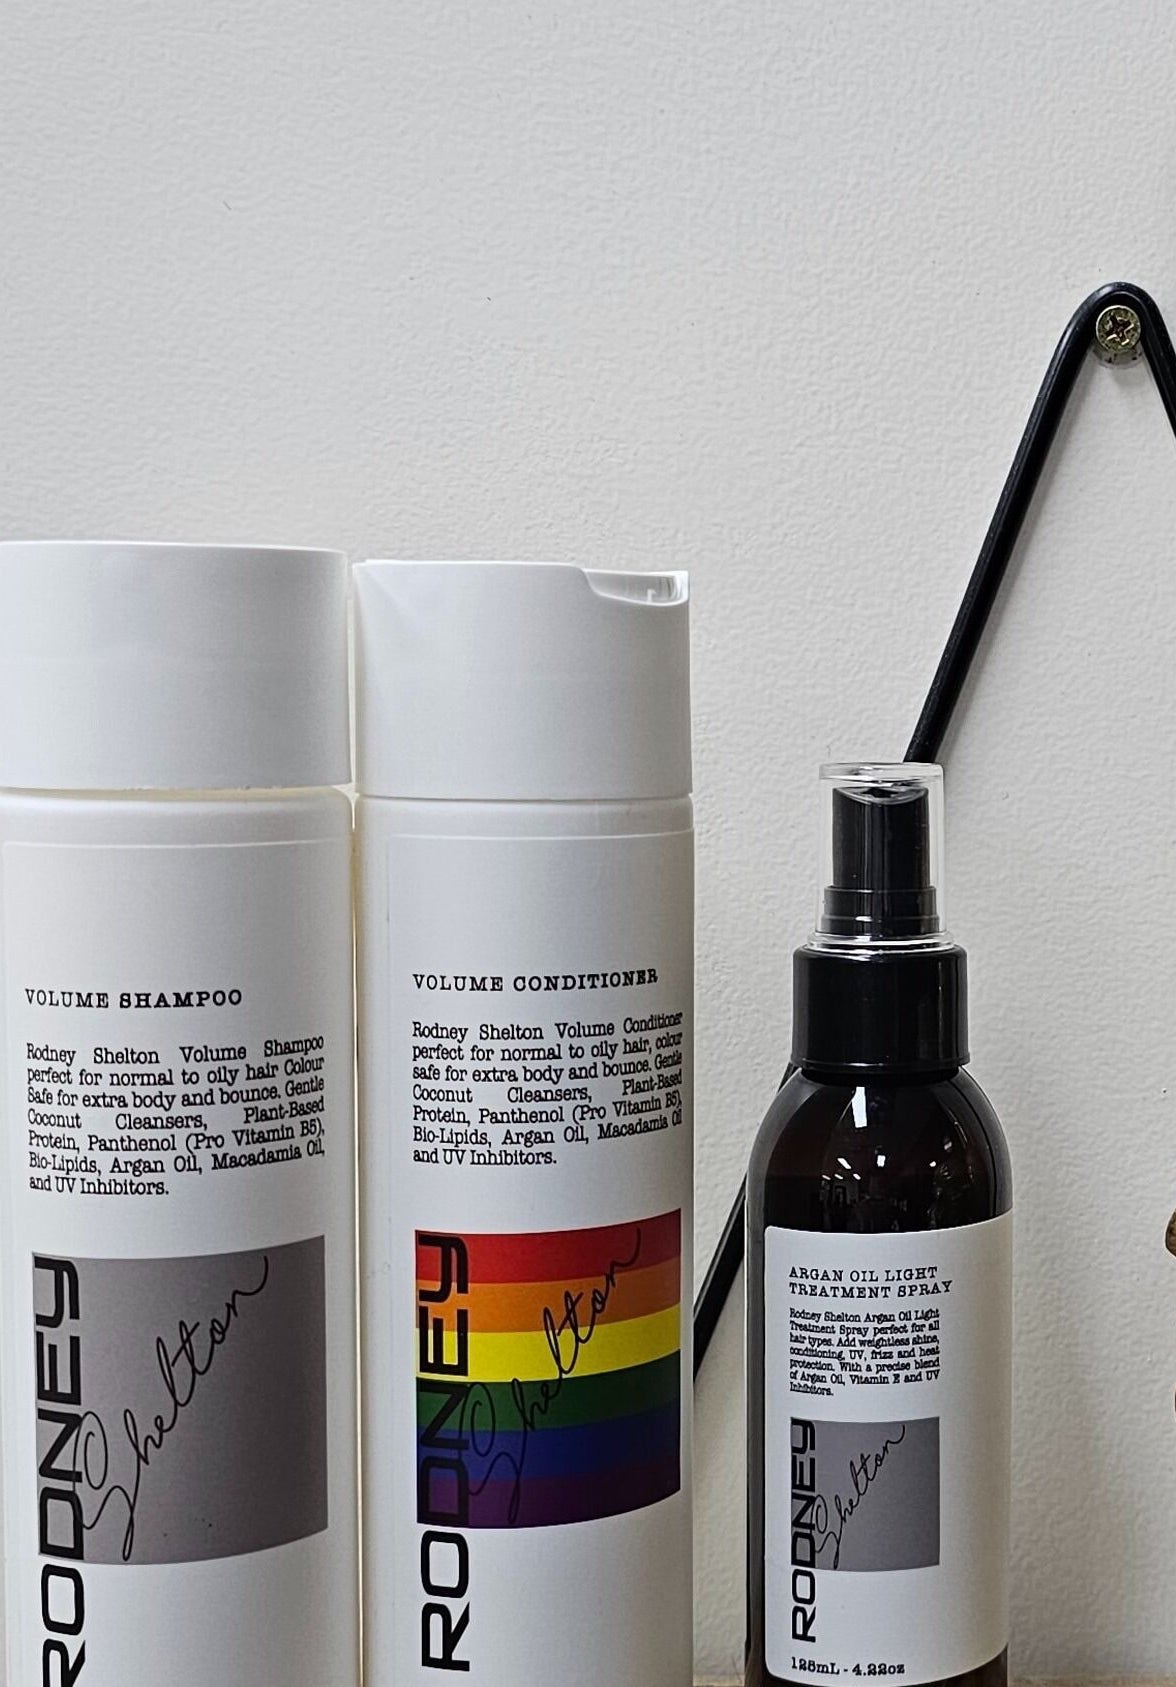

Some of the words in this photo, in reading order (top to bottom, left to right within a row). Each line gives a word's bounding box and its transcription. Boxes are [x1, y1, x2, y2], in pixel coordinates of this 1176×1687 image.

[413, 974, 503, 992] VOLUME
[513, 968, 658, 992] CONDITIONER
[25, 989, 109, 1009] VOLUME
[119, 989, 242, 1009] SHAMPOO
[412, 1022, 468, 1044] Rodney
[479, 1024, 543, 1041] Shelton
[555, 1022, 614, 1039] Volume
[27, 1043, 76, 1065] Rodney
[93, 1048, 159, 1064] Shelton
[179, 1045, 246, 1063] Volume
[264, 1036, 324, 1057] Shampoo
[412, 1045, 464, 1061] perfect
[470, 1045, 494, 1060] for
[501, 1044, 562, 1061] normal
[569, 1043, 584, 1058] to
[591, 1042, 617, 1060] oily
[27, 1067, 73, 1084] perfect
[79, 1069, 102, 1085] for
[109, 1069, 173, 1086] normal
[182, 1068, 199, 1084] to
[207, 1067, 239, 1086] oily
[246, 1065, 278, 1081] hair
[284, 1057, 324, 1076] Colour
[412, 1065, 440, 1080] safe
[445, 1065, 467, 1081] for
[472, 1068, 518, 1082] extra
[523, 1066, 564, 1084] body
[569, 1063, 597, 1080] and
[28, 1087, 53, 1105] Safe
[57, 1090, 78, 1106] for
[82, 1093, 128, 1108] extra
[132, 1091, 175, 1111] body
[181, 1089, 215, 1106] and
[220, 1084, 281, 1105] bounce.
[285, 1076, 324, 1097] Gentle
[413, 1084, 473, 1103] Coconut
[507, 1087, 592, 1103] Cleansers,
[622, 1069, 682, 1096] Plant-Based
[28, 1109, 81, 1128] Coconut
[116, 1114, 208, 1131] Cleansers,
[244, 1099, 324, 1124] Plant-Based
[413, 1105, 471, 1126] Protein,
[479, 1106, 564, 1124] Panthenol
[573, 1104, 606, 1125] (Pro
[613, 1096, 661, 1117] Vitamin
[28, 1131, 80, 1153] Protein,
[88, 1135, 177, 1151] Panthenol
[186, 1133, 224, 1155] (Pro
[233, 1126, 294, 1146] Vitamin
[413, 1126, 492, 1148] Bio-Lipids,
[502, 1130, 554, 1147] Argan
[564, 1125, 589, 1144] Oil,
[598, 1116, 668, 1141] Macadamia
[29, 1153, 101, 1176] Bio-Lipids,
[110, 1158, 165, 1176] Argan
[174, 1155, 202, 1175] Oil,
[211, 1144, 301, 1171] Macadamia
[413, 1149, 438, 1163] and
[443, 1150, 466, 1165] UV
[470, 1150, 557, 1166] Inhibitors.
[29, 1175, 52, 1191] and
[55, 1177, 76, 1193] UV
[80, 1178, 169, 1195] Inhibitors.
[789, 1267, 843, 1281] ARGAN
[850, 1271, 878, 1282] OIL
[885, 1267, 937, 1281] LIGHT
[789, 1282, 891, 1298] TREATMENT
[898, 1280, 952, 1297] SPRAY
[790, 1308, 821, 1322] Rodney
[824, 1312, 861, 1322] Shelton
[864, 1312, 895, 1324] Argan
[899, 1310, 912, 1321] Oil
[914, 1309, 939, 1321] Light
[790, 1321, 835, 1334] Treatment
[840, 1325, 869, 1337] Spray
[873, 1324, 908, 1336] perfect
[911, 1323, 926, 1332] for
[928, 1320, 939, 1331] all
[837, 1337, 856, 1347] Add
[859, 1336, 910, 1349] weightless
[871, 1350, 893, 1360] frizz
[897, 1348, 915, 1358] and
[919, 1347, 940, 1357] heat
[461, 1228, 640, 1524] Shelton
[800, 1373, 827, 1384] Argan
[850, 1374, 889, 1384] Vitamin
[904, 1372, 922, 1383] and
[926, 1370, 940, 1381] UV
[840, 1362, 861, 1373] With
[866, 1364, 872, 1372] a
[72, 1255, 268, 1561] Shelton
[416, 1231, 471, 1672] RODNEY
[34, 1254, 86, 1687] RODNEY
[811, 1425, 905, 1569] Shelton
[791, 1418, 816, 1643] RODNEY
